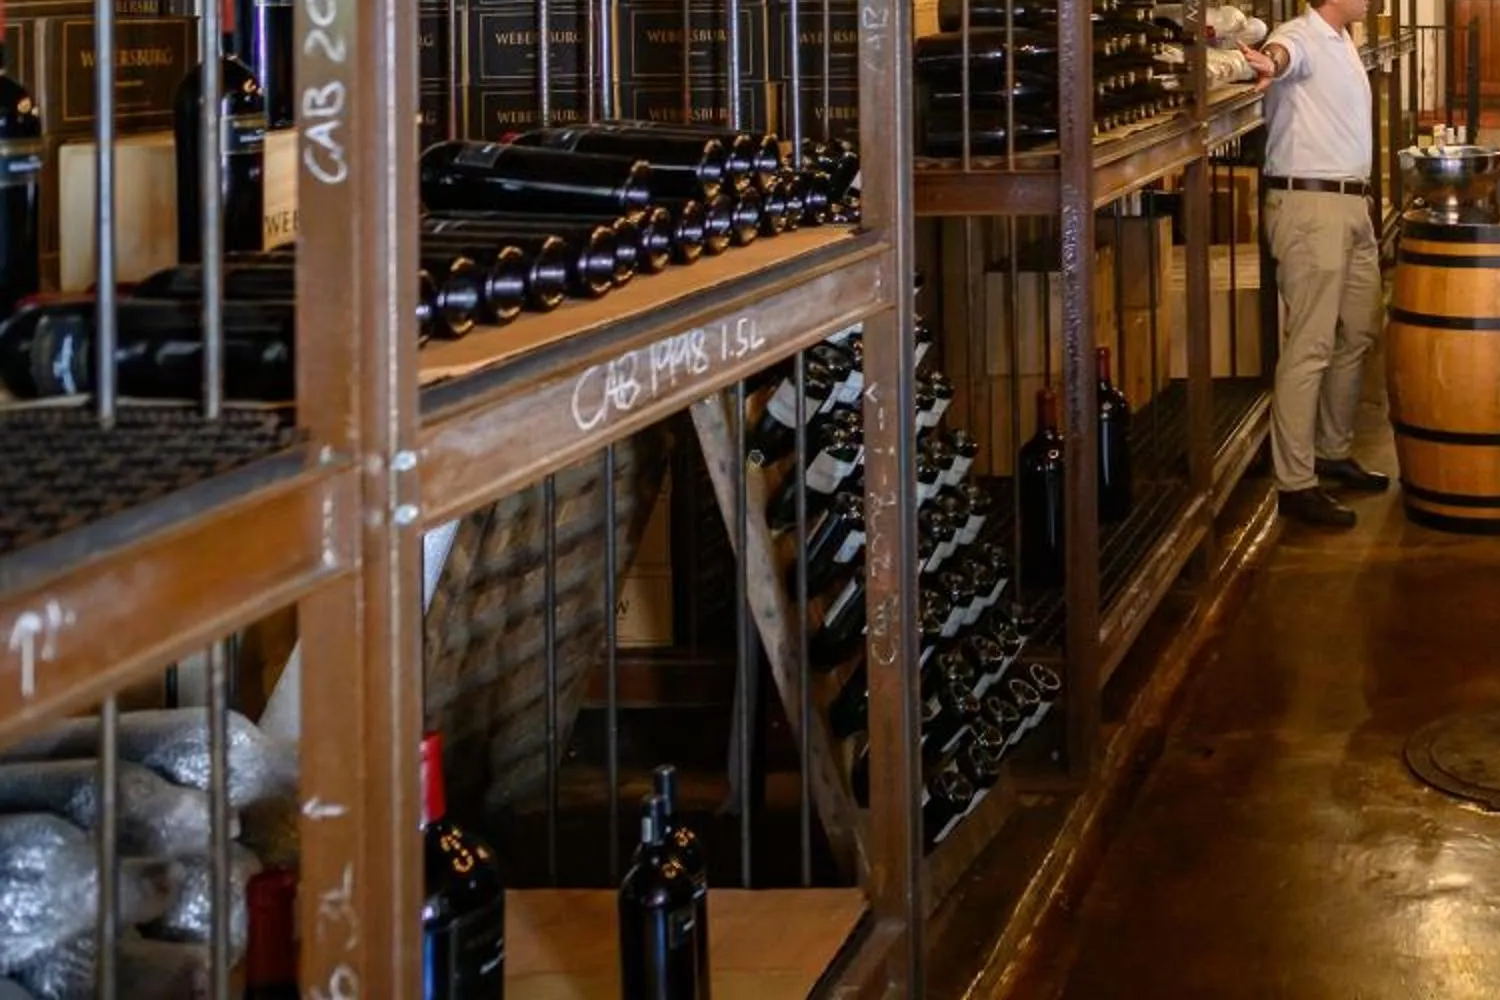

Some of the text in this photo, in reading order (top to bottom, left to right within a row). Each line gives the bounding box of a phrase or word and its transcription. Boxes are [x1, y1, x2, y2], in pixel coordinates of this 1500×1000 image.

[303, 79, 348, 185] CAB
[571, 317, 767, 432] CAB 1998 1.5L
